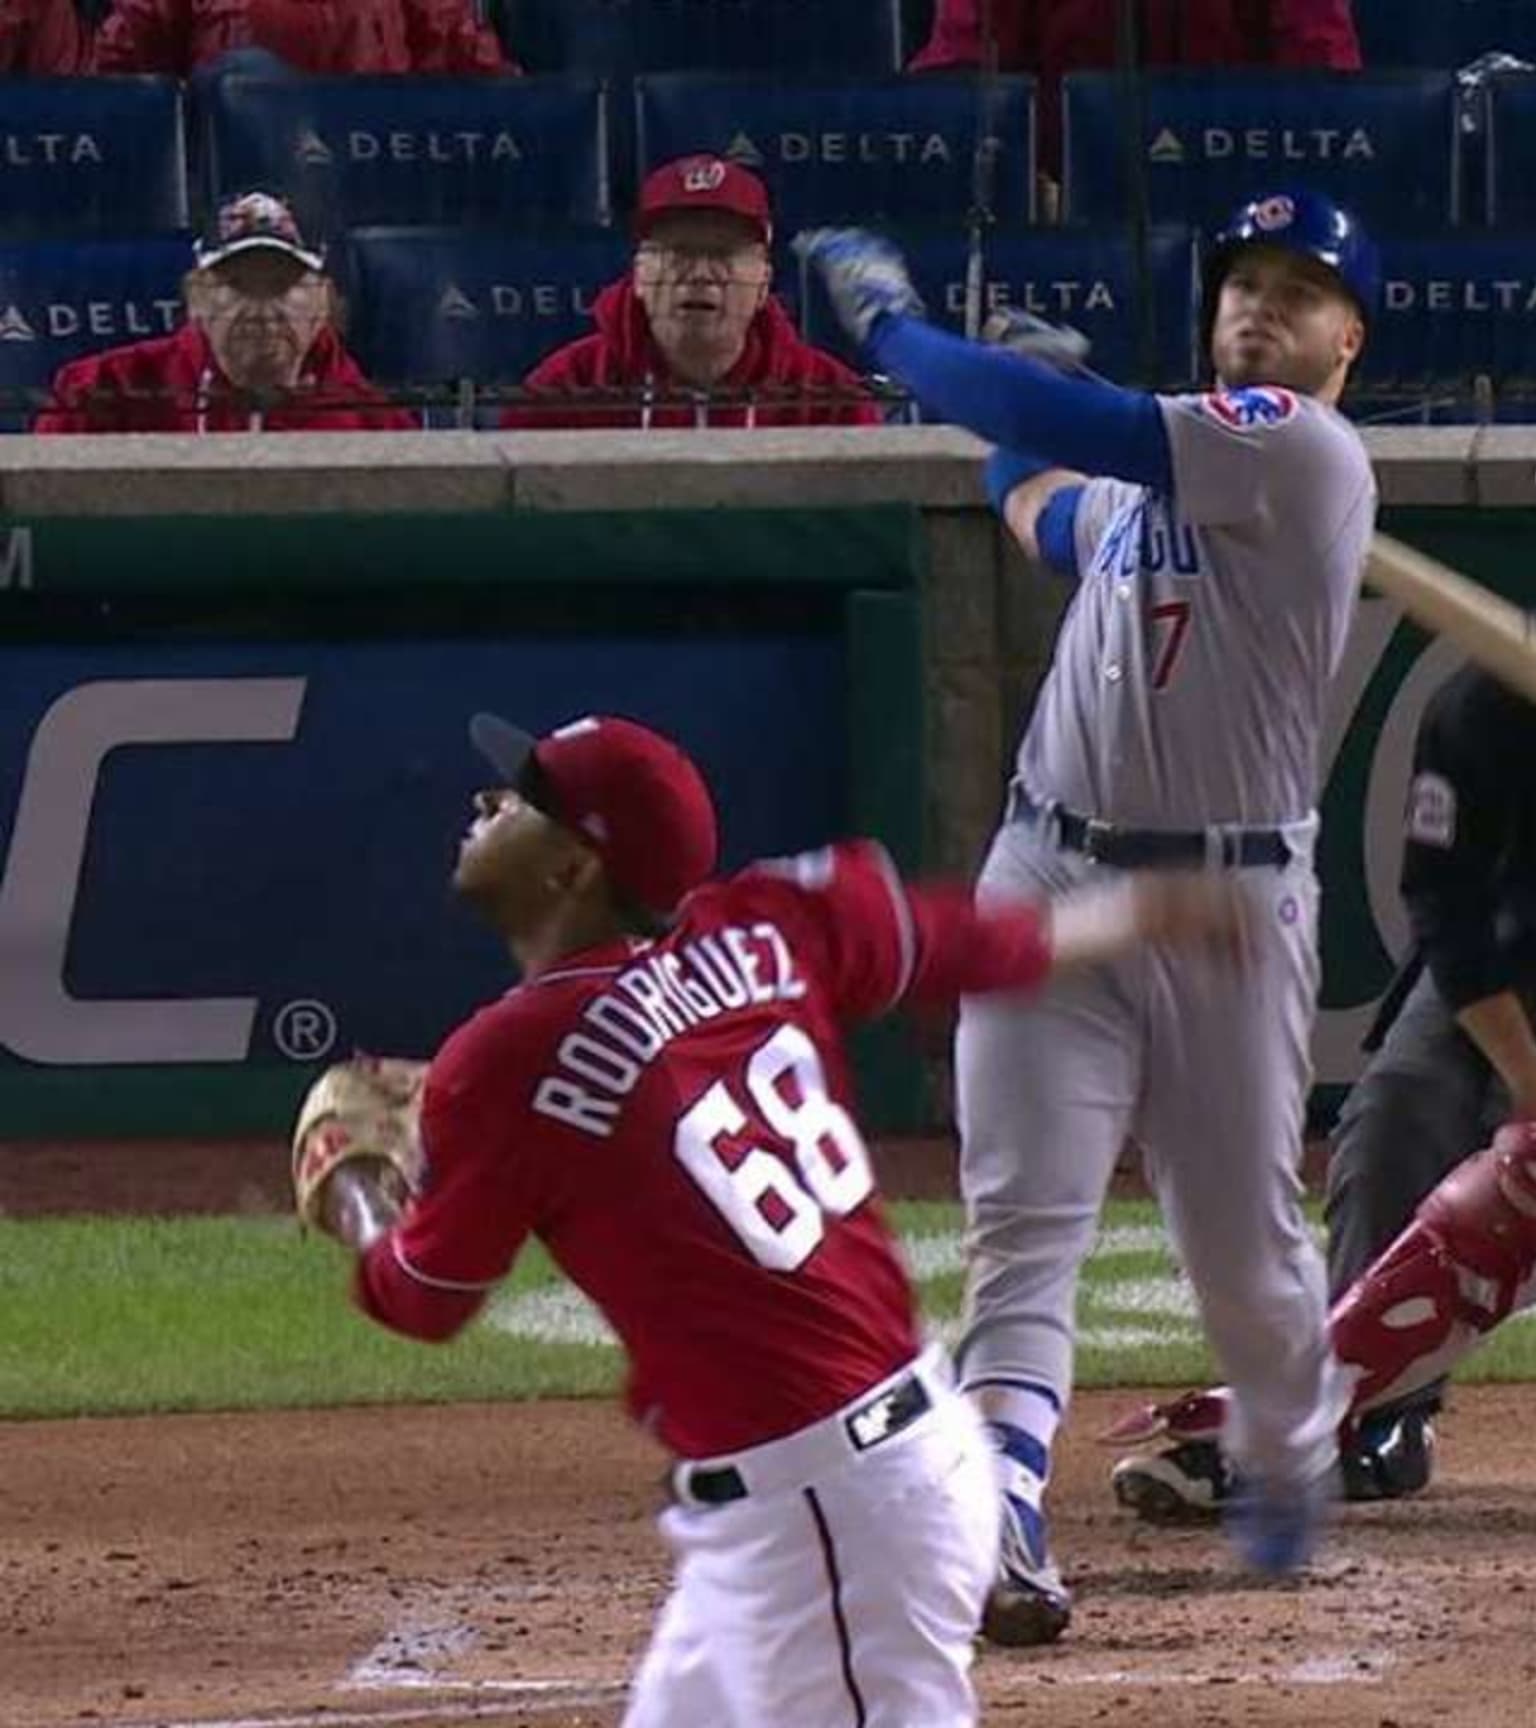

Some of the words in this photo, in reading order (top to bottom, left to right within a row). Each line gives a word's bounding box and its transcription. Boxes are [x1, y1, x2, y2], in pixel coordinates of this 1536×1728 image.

[348, 132, 522, 161] DELTA
[780, 132, 952, 162] DELTA
[1204, 128, 1376, 158] DELTA
[1150, 600, 1191, 690] 7
[533, 922, 806, 1138] RODRIGUEZ
[675, 1022, 875, 1273] 68
